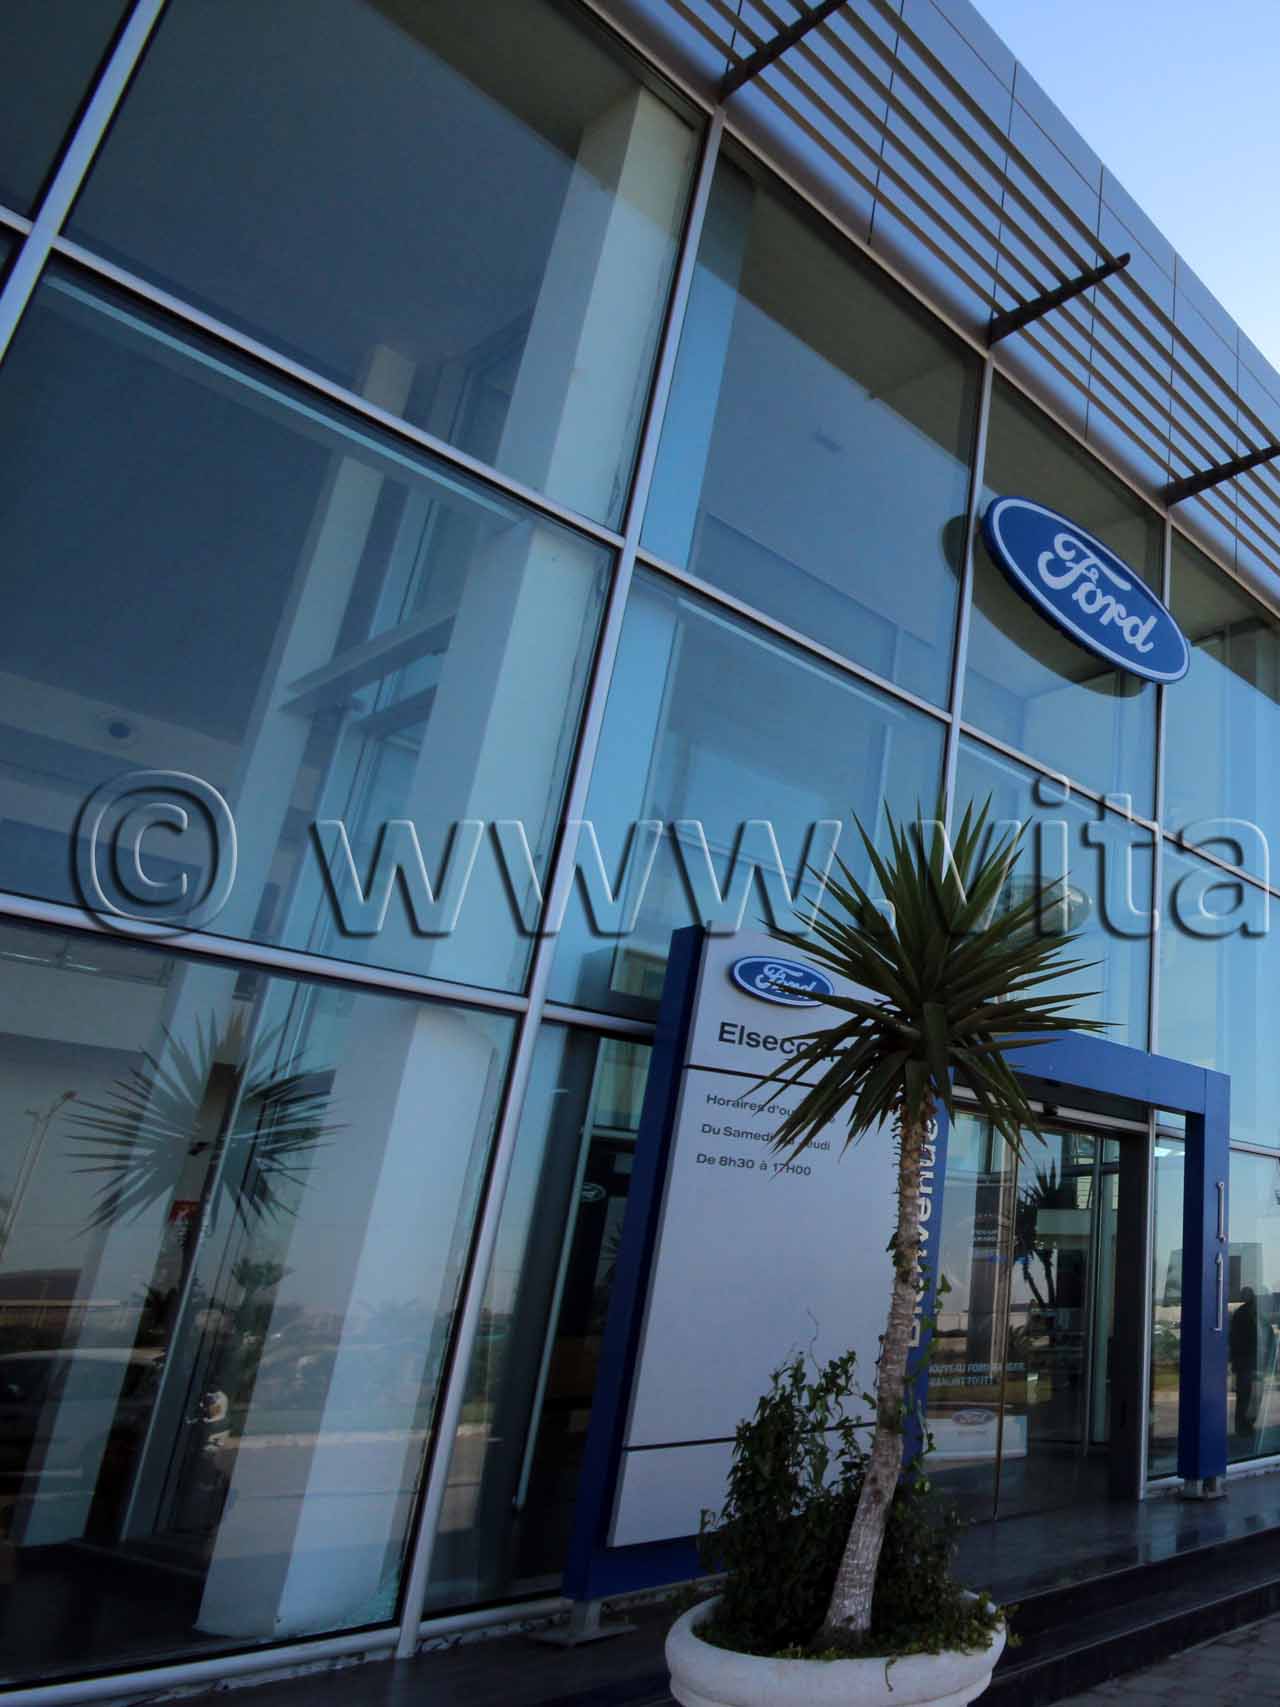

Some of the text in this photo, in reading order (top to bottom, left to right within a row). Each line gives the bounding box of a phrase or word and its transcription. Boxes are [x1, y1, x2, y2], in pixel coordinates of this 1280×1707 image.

[1037, 532, 1158, 654] Ford
[718, 1021, 847, 1063] Elseco
[706, 1093, 765, 1113] Horaires
[701, 1123, 721, 1136] Du
[696, 1152, 812, 1177] De 8h30 à 17H00
